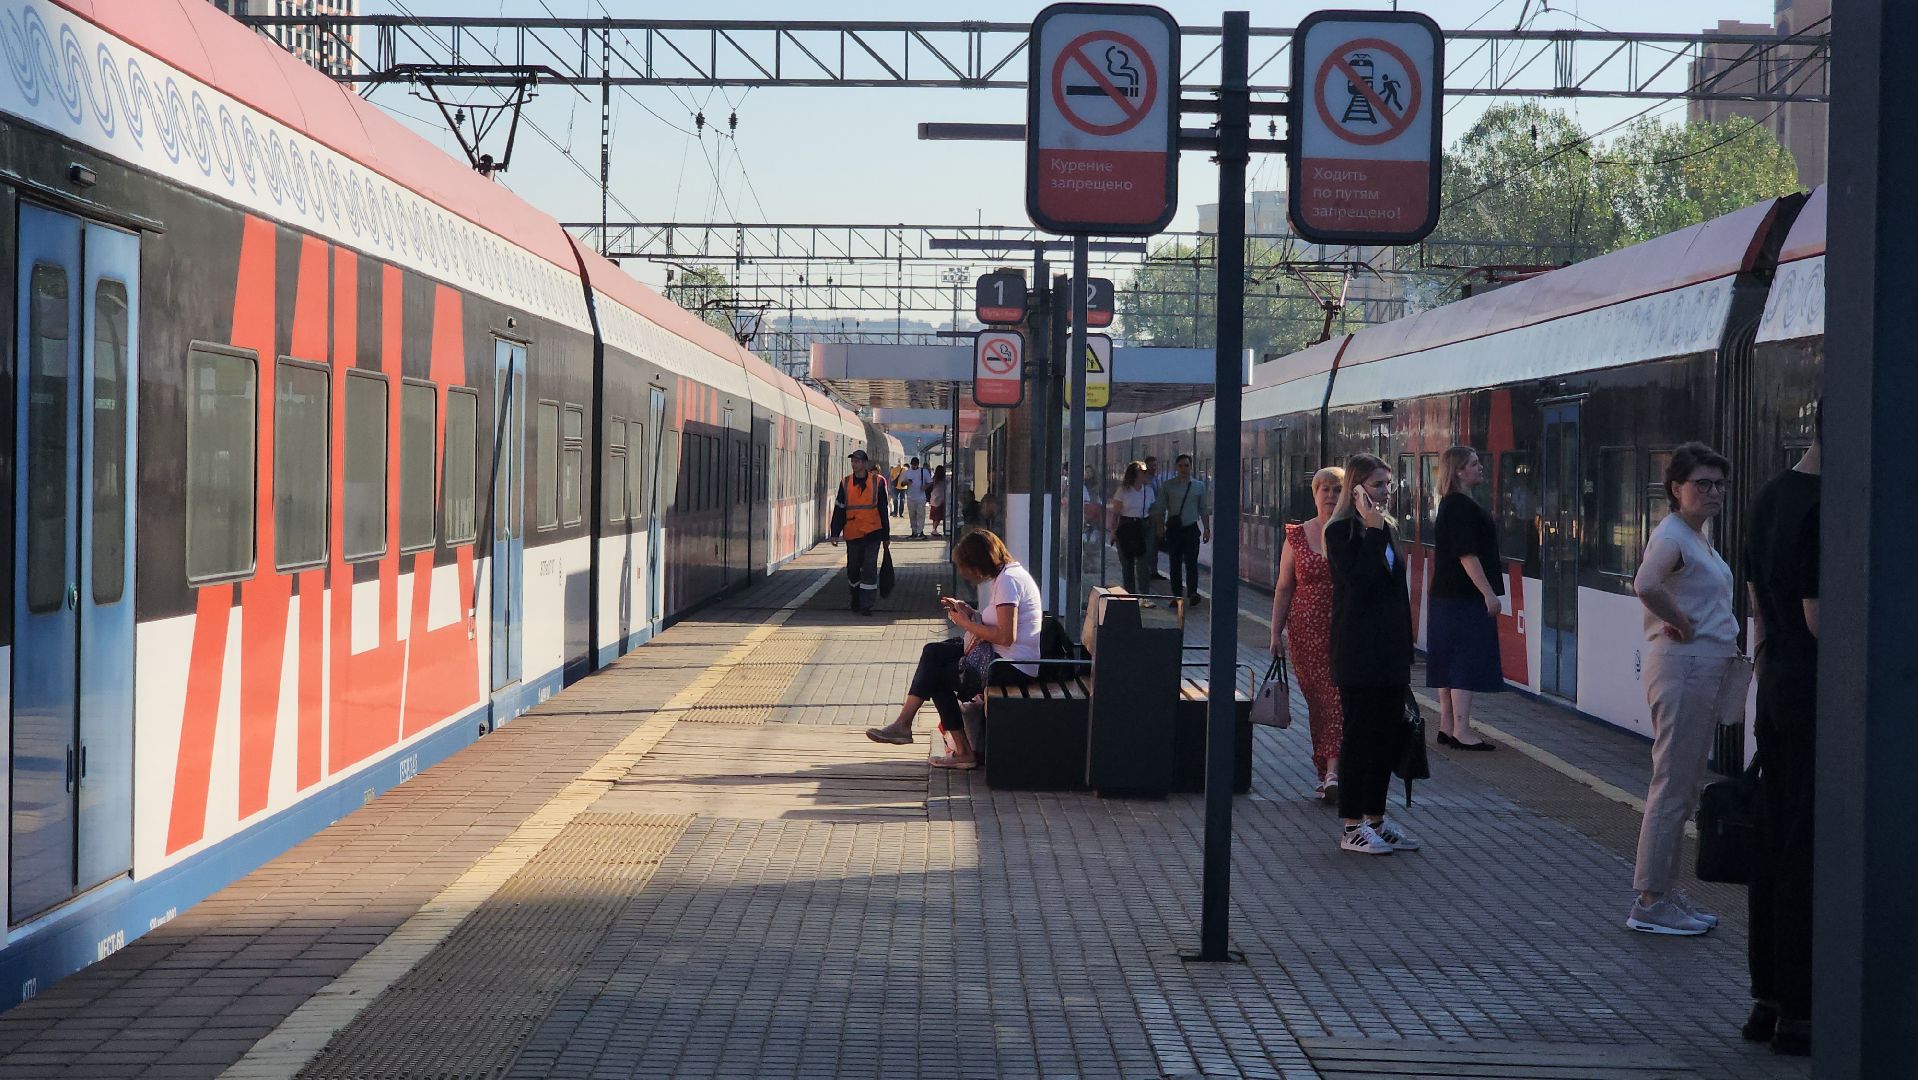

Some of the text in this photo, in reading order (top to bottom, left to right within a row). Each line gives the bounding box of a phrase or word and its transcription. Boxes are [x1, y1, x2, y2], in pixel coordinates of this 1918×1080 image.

[1051, 157, 1113, 173] Курение
[1313, 167, 1367, 182] Ходить
[1051, 177, 1133, 192] запрещено
[1313, 188, 1379, 201] по путям
[1312, 207, 1401, 221] запрещено!
[993, 280, 1004, 306] 1
[1087, 285, 1097, 309] 2
[165, 213, 481, 857] МЦД
